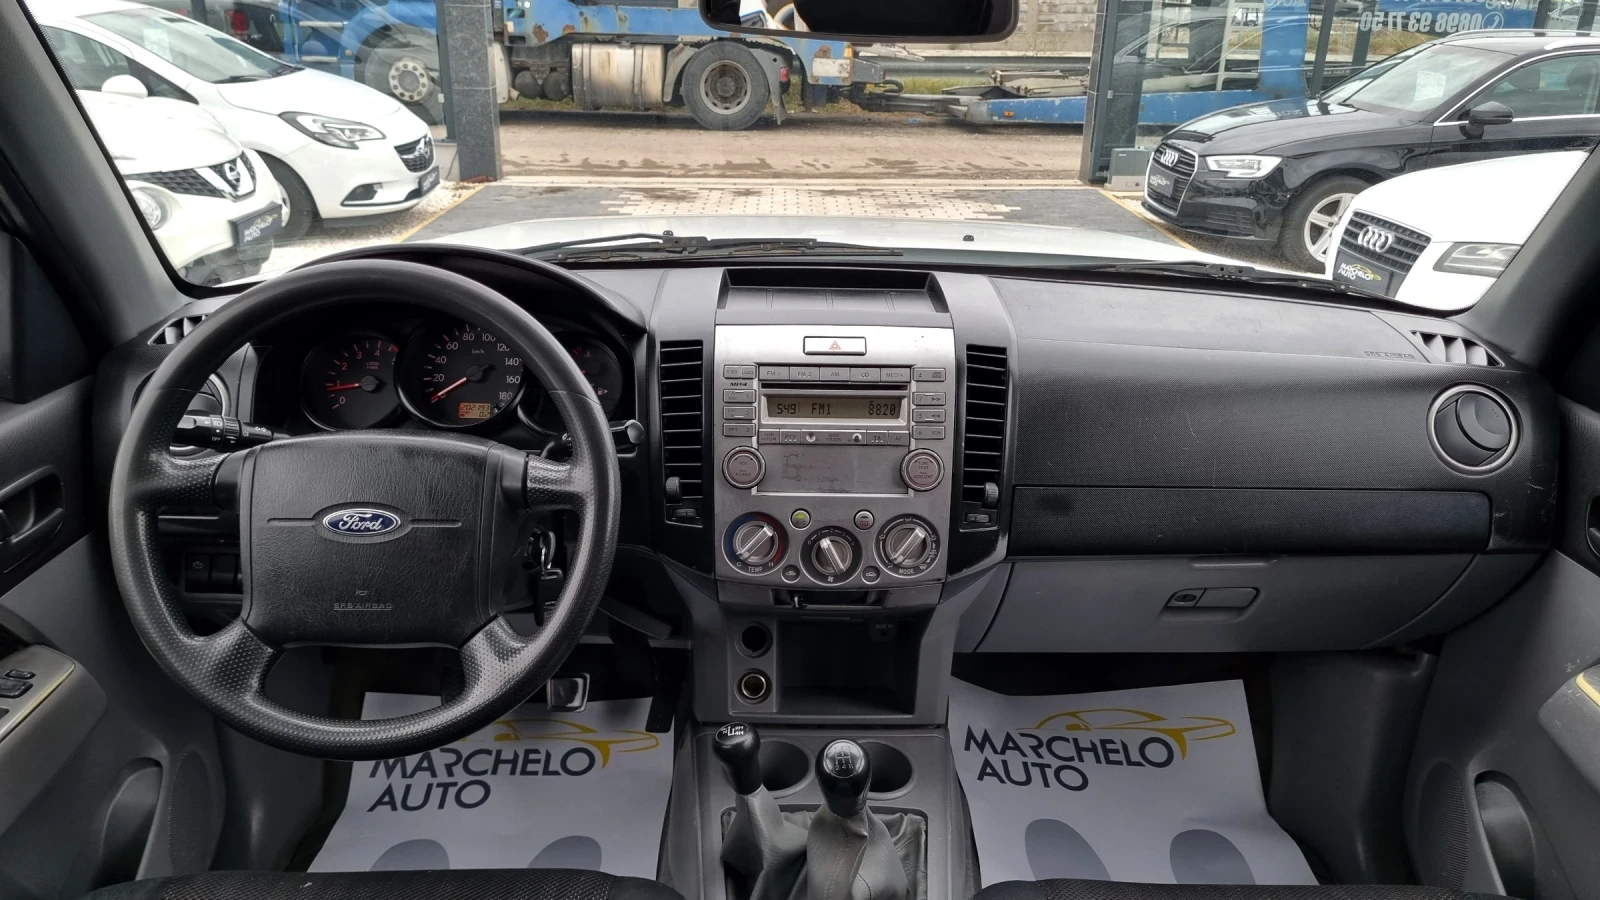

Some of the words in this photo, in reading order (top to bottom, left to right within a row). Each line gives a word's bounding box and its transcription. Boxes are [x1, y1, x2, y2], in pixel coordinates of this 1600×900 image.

[463, 332, 475, 341] 80
[446, 342, 459, 350] 60
[356, 351, 362, 359] 3
[434, 356, 447, 364] 40
[505, 357, 519, 366] 140
[341, 362, 348, 370] 2
[433, 373, 445, 381] 20
[506, 375, 520, 384] 160
[340, 396, 346, 404] 0
[499, 391, 512, 400] 180
[811, 403, 831, 415] FM1
[339, 513, 383, 530] Ford
[964, 724, 1175, 768] MARCHELO
[369, 747, 596, 781] MARCHELO
[977, 756, 1089, 792] AUTO
[367, 780, 491, 813] AUTO
